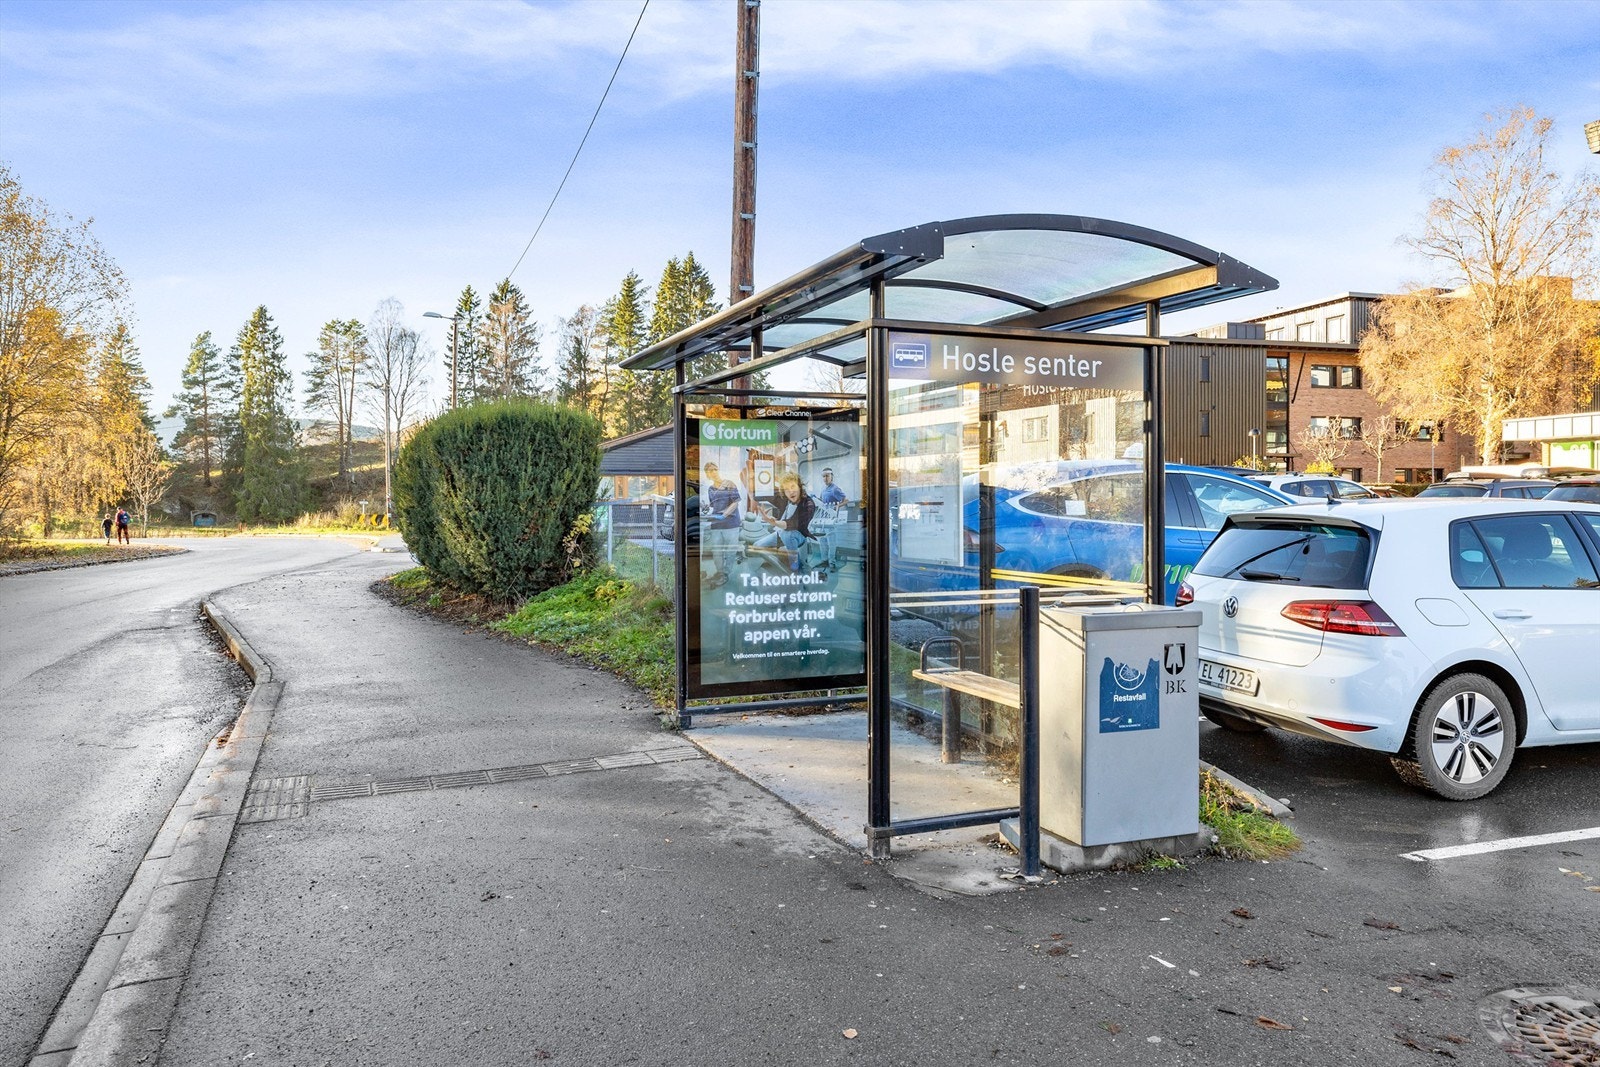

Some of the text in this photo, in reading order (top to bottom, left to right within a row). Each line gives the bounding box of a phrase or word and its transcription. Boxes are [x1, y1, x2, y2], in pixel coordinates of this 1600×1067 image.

[942, 344, 1103, 378] Hosle senter
[766, 409, 812, 417] Clear Channel
[717, 423, 772, 440] fortum
[740, 571, 823, 587] Ta kontroll.
[725, 590, 838, 606] Reduser strøm-
[728, 606, 835, 624] forbruket med
[744, 623, 821, 644] appen vår.
[732, 652, 766, 660] Velkommen
[1201, 663, 1213, 680] EL
[1217, 667, 1253, 689] 41223
[1166, 679, 1187, 694] BK
[1113, 692, 1147, 702] Restavfall
